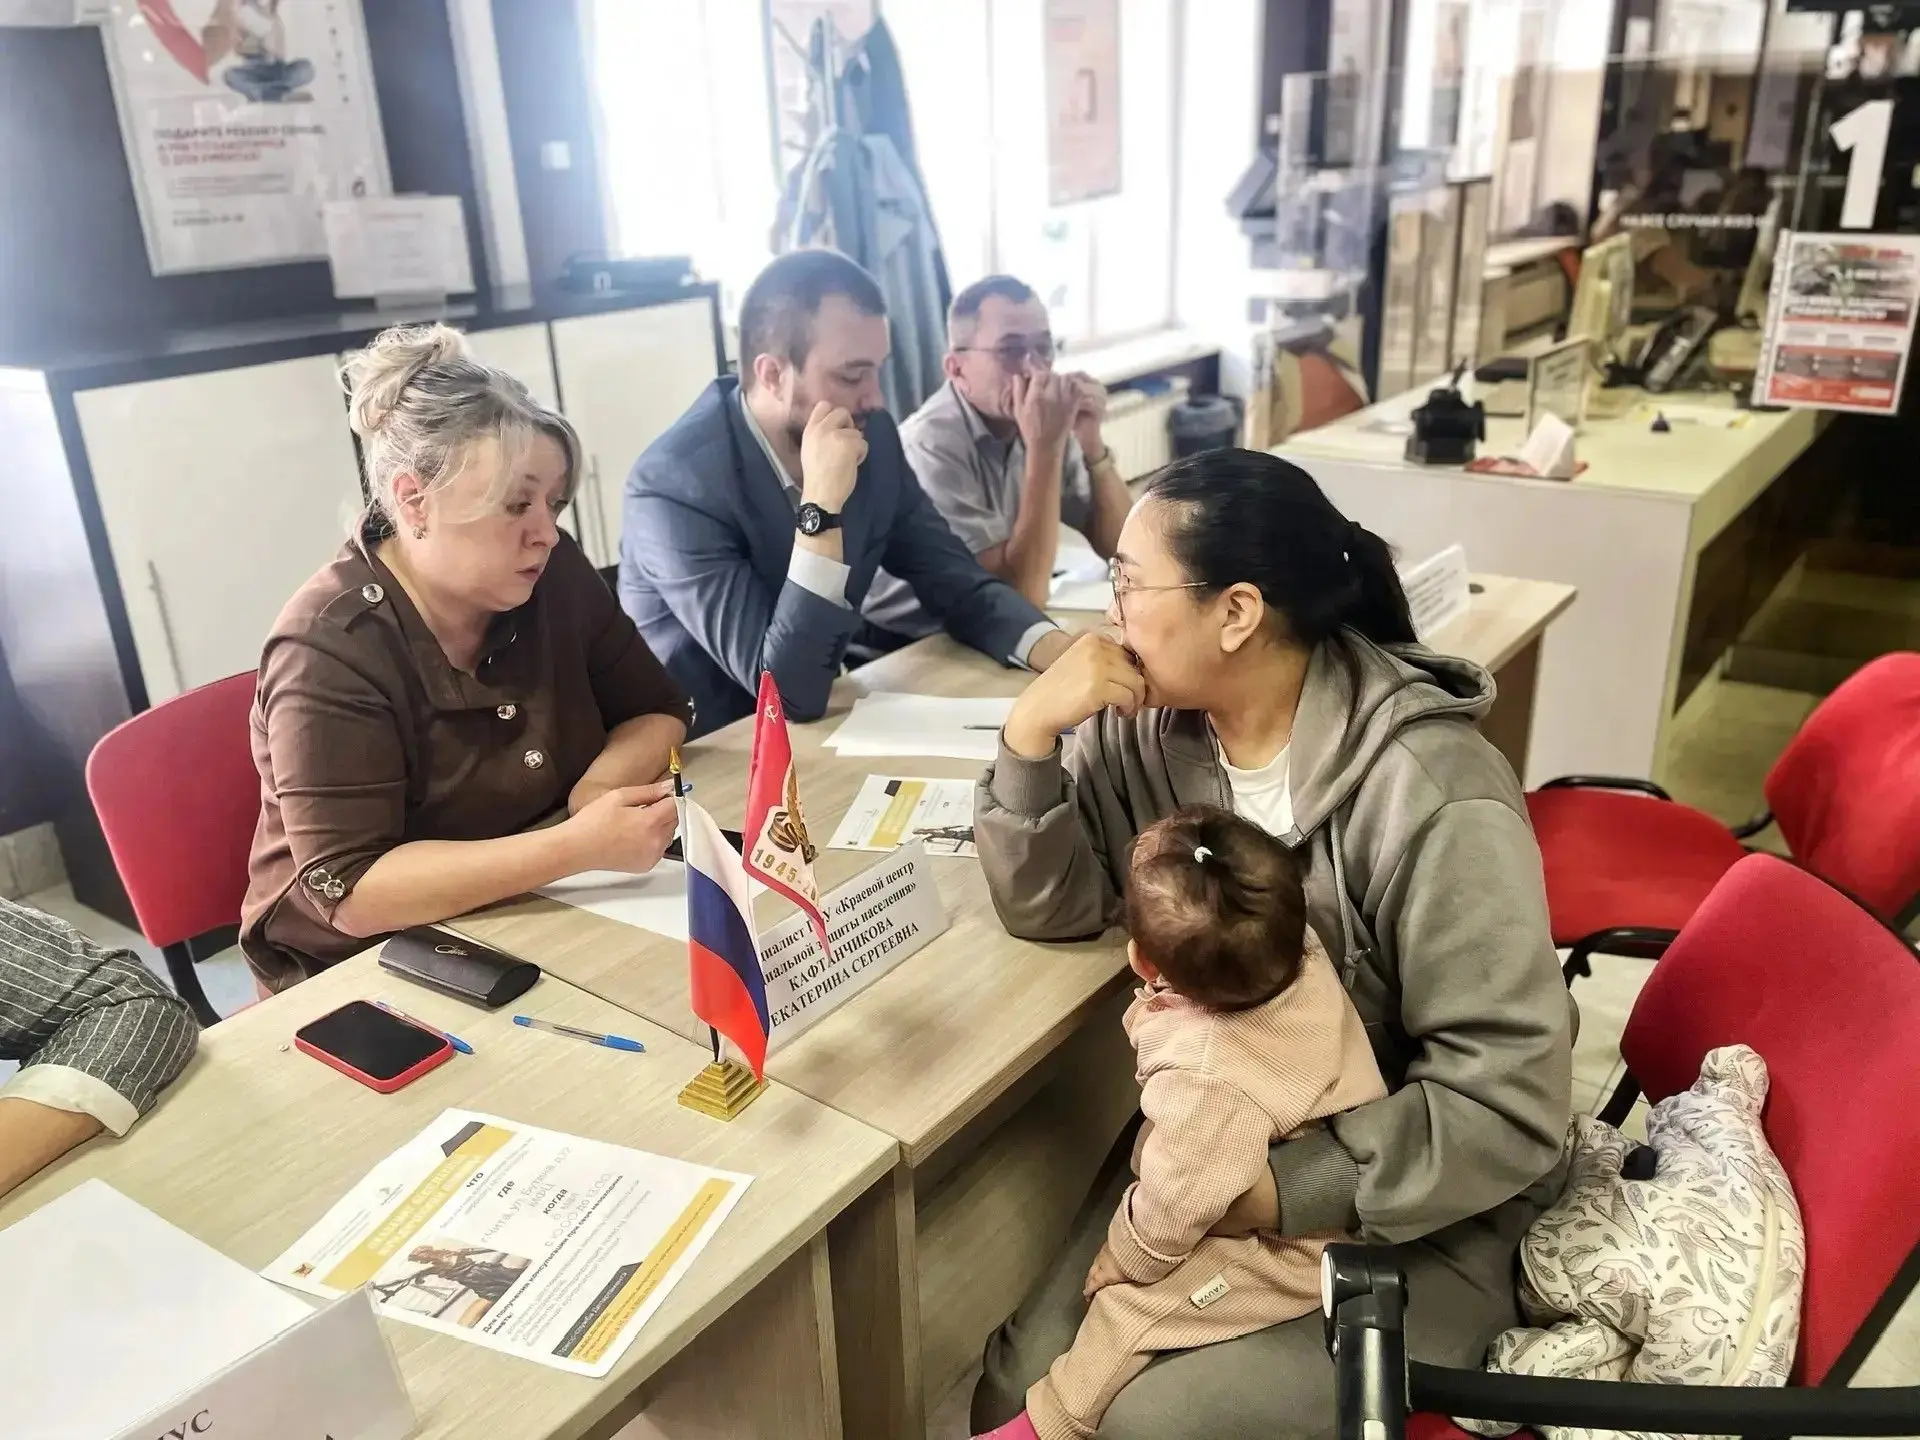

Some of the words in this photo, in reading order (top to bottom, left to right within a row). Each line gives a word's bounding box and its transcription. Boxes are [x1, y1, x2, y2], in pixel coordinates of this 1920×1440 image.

[1829, 99, 1895, 229] 1
[818, 918, 860, 951] зщиты
[860, 881, 917, 923] населения»
[835, 876, 885, 916] «Краевой
[885, 861, 915, 885] центр
[770, 967, 851, 1027] ЕКАТЕРИНА
[851, 922, 919, 974] СЕРГЕЕВНА
[788, 917, 894, 992] КАФТАНЧИКОВА
[497, 1180, 515, 1198] где
[543, 1188, 568, 1215] когда
[1198, 1283, 1226, 1304] VAUVA
